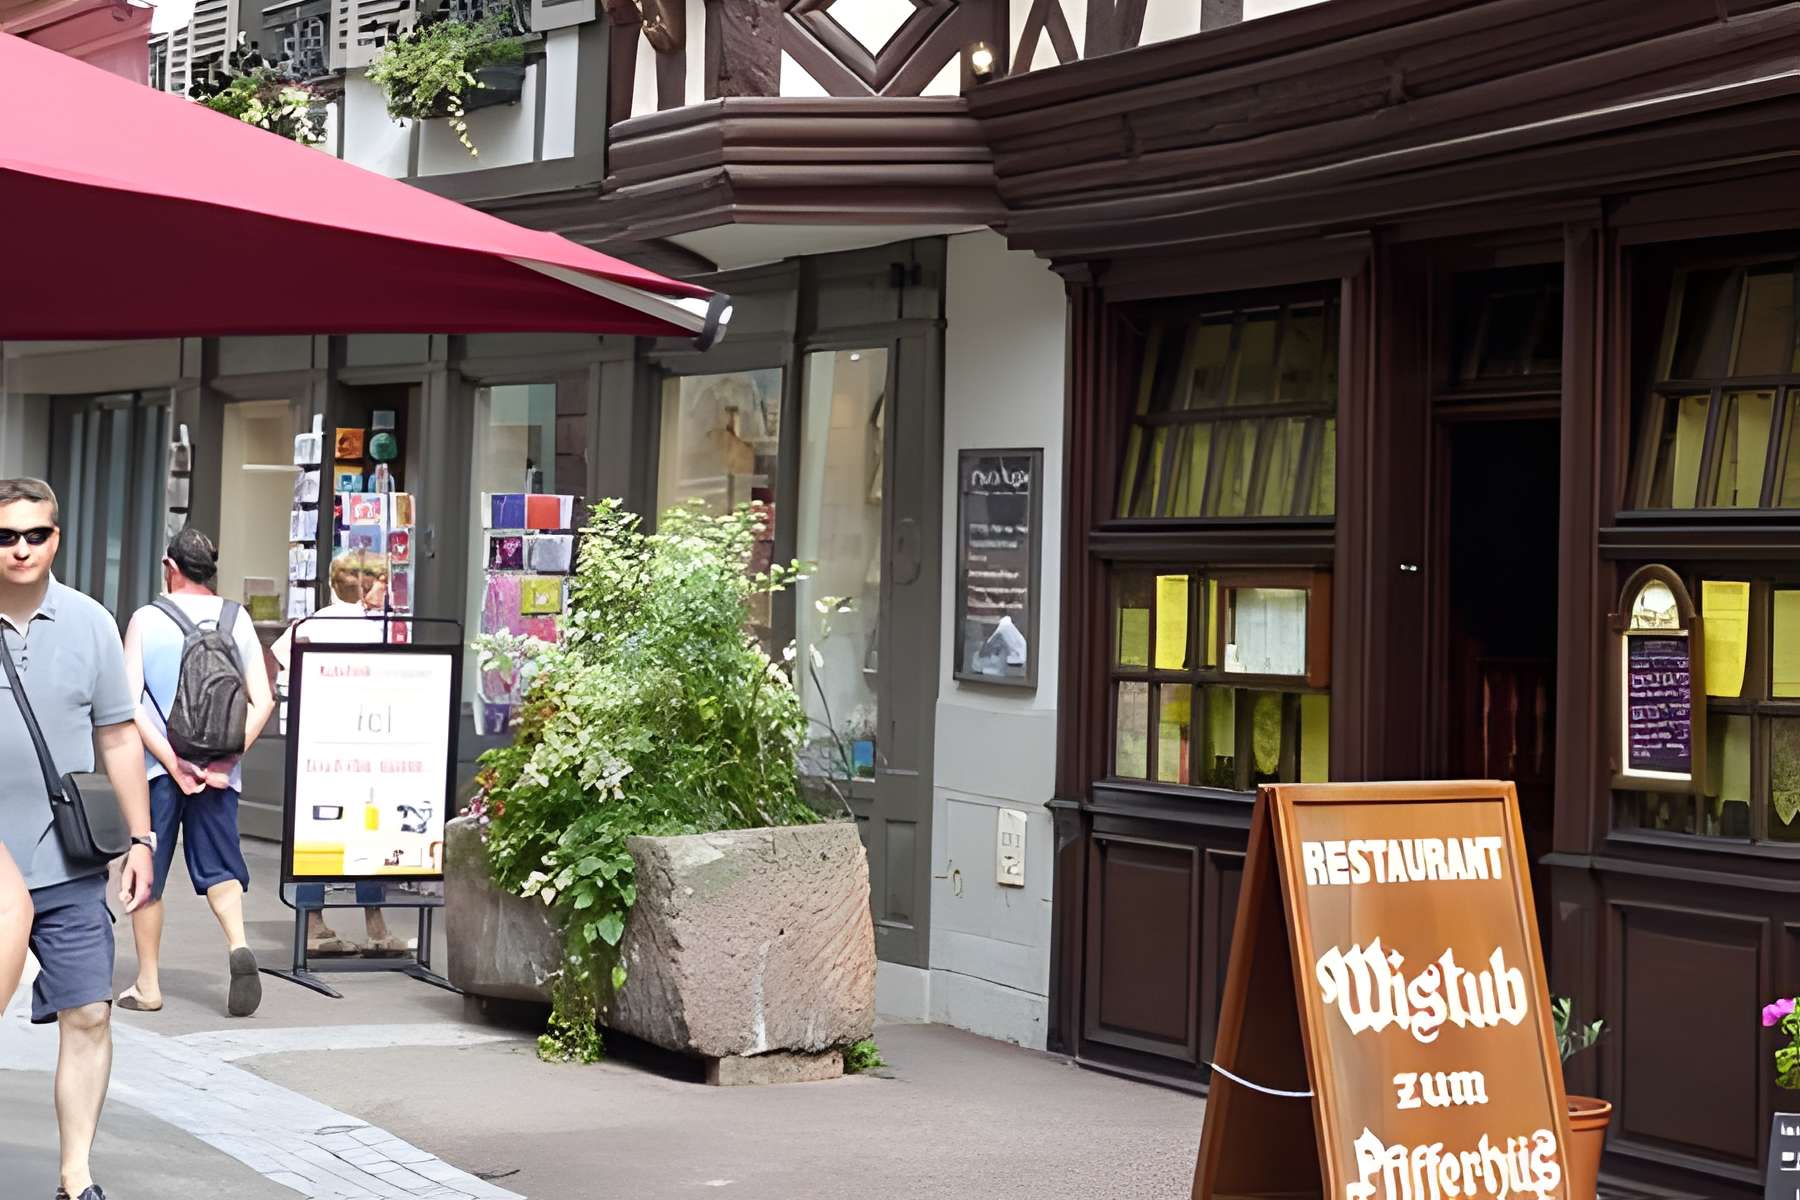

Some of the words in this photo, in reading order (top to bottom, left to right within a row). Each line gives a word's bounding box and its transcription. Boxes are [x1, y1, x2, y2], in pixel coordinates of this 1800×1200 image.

[1301, 836, 1504, 887] RESTAURANT
[1315, 936, 1528, 1044] Wistub
[1393, 1069, 1489, 1110] zum
